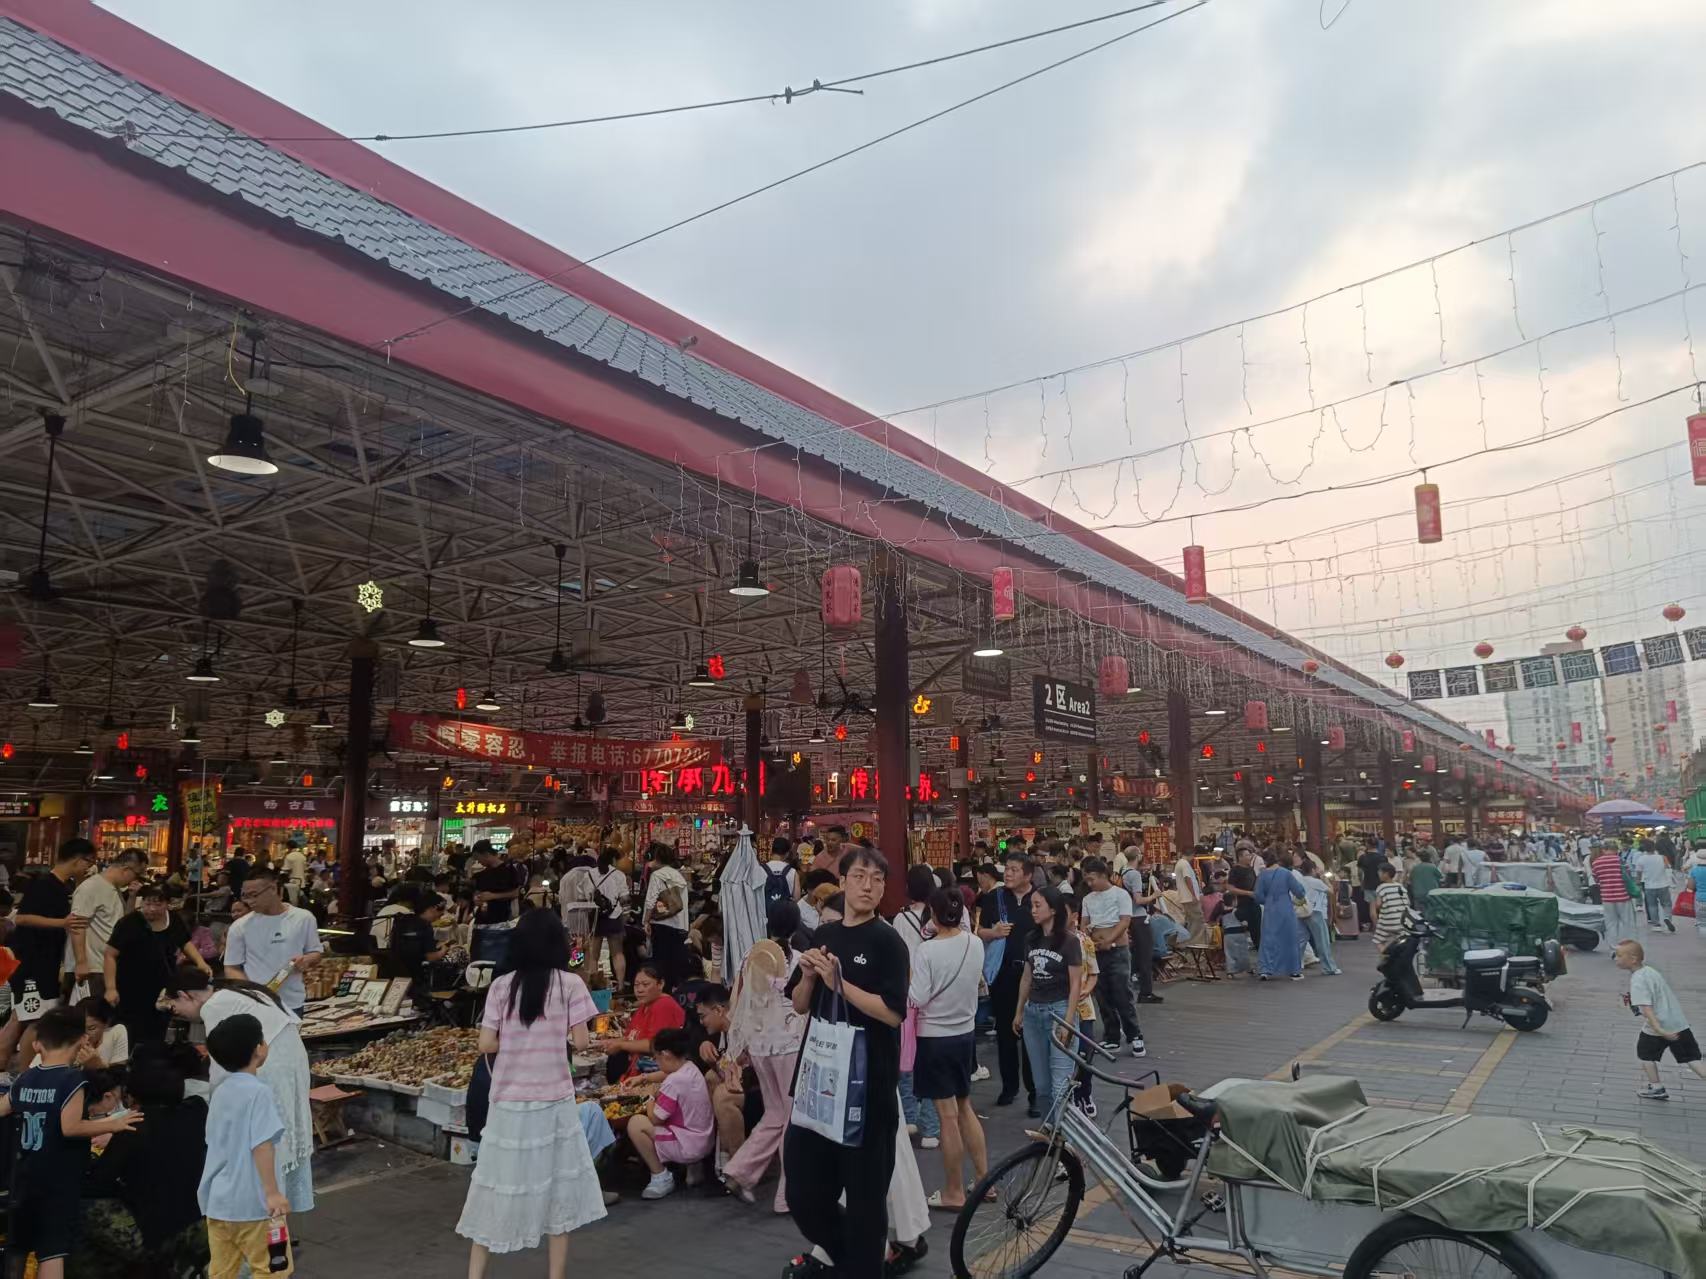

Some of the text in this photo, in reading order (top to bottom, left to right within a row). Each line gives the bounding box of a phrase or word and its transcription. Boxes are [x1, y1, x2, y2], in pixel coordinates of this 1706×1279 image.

[1069, 697, 1091, 715] Area2
[640, 760, 766, 797] 传承九
[853, 953, 867, 965] alo
